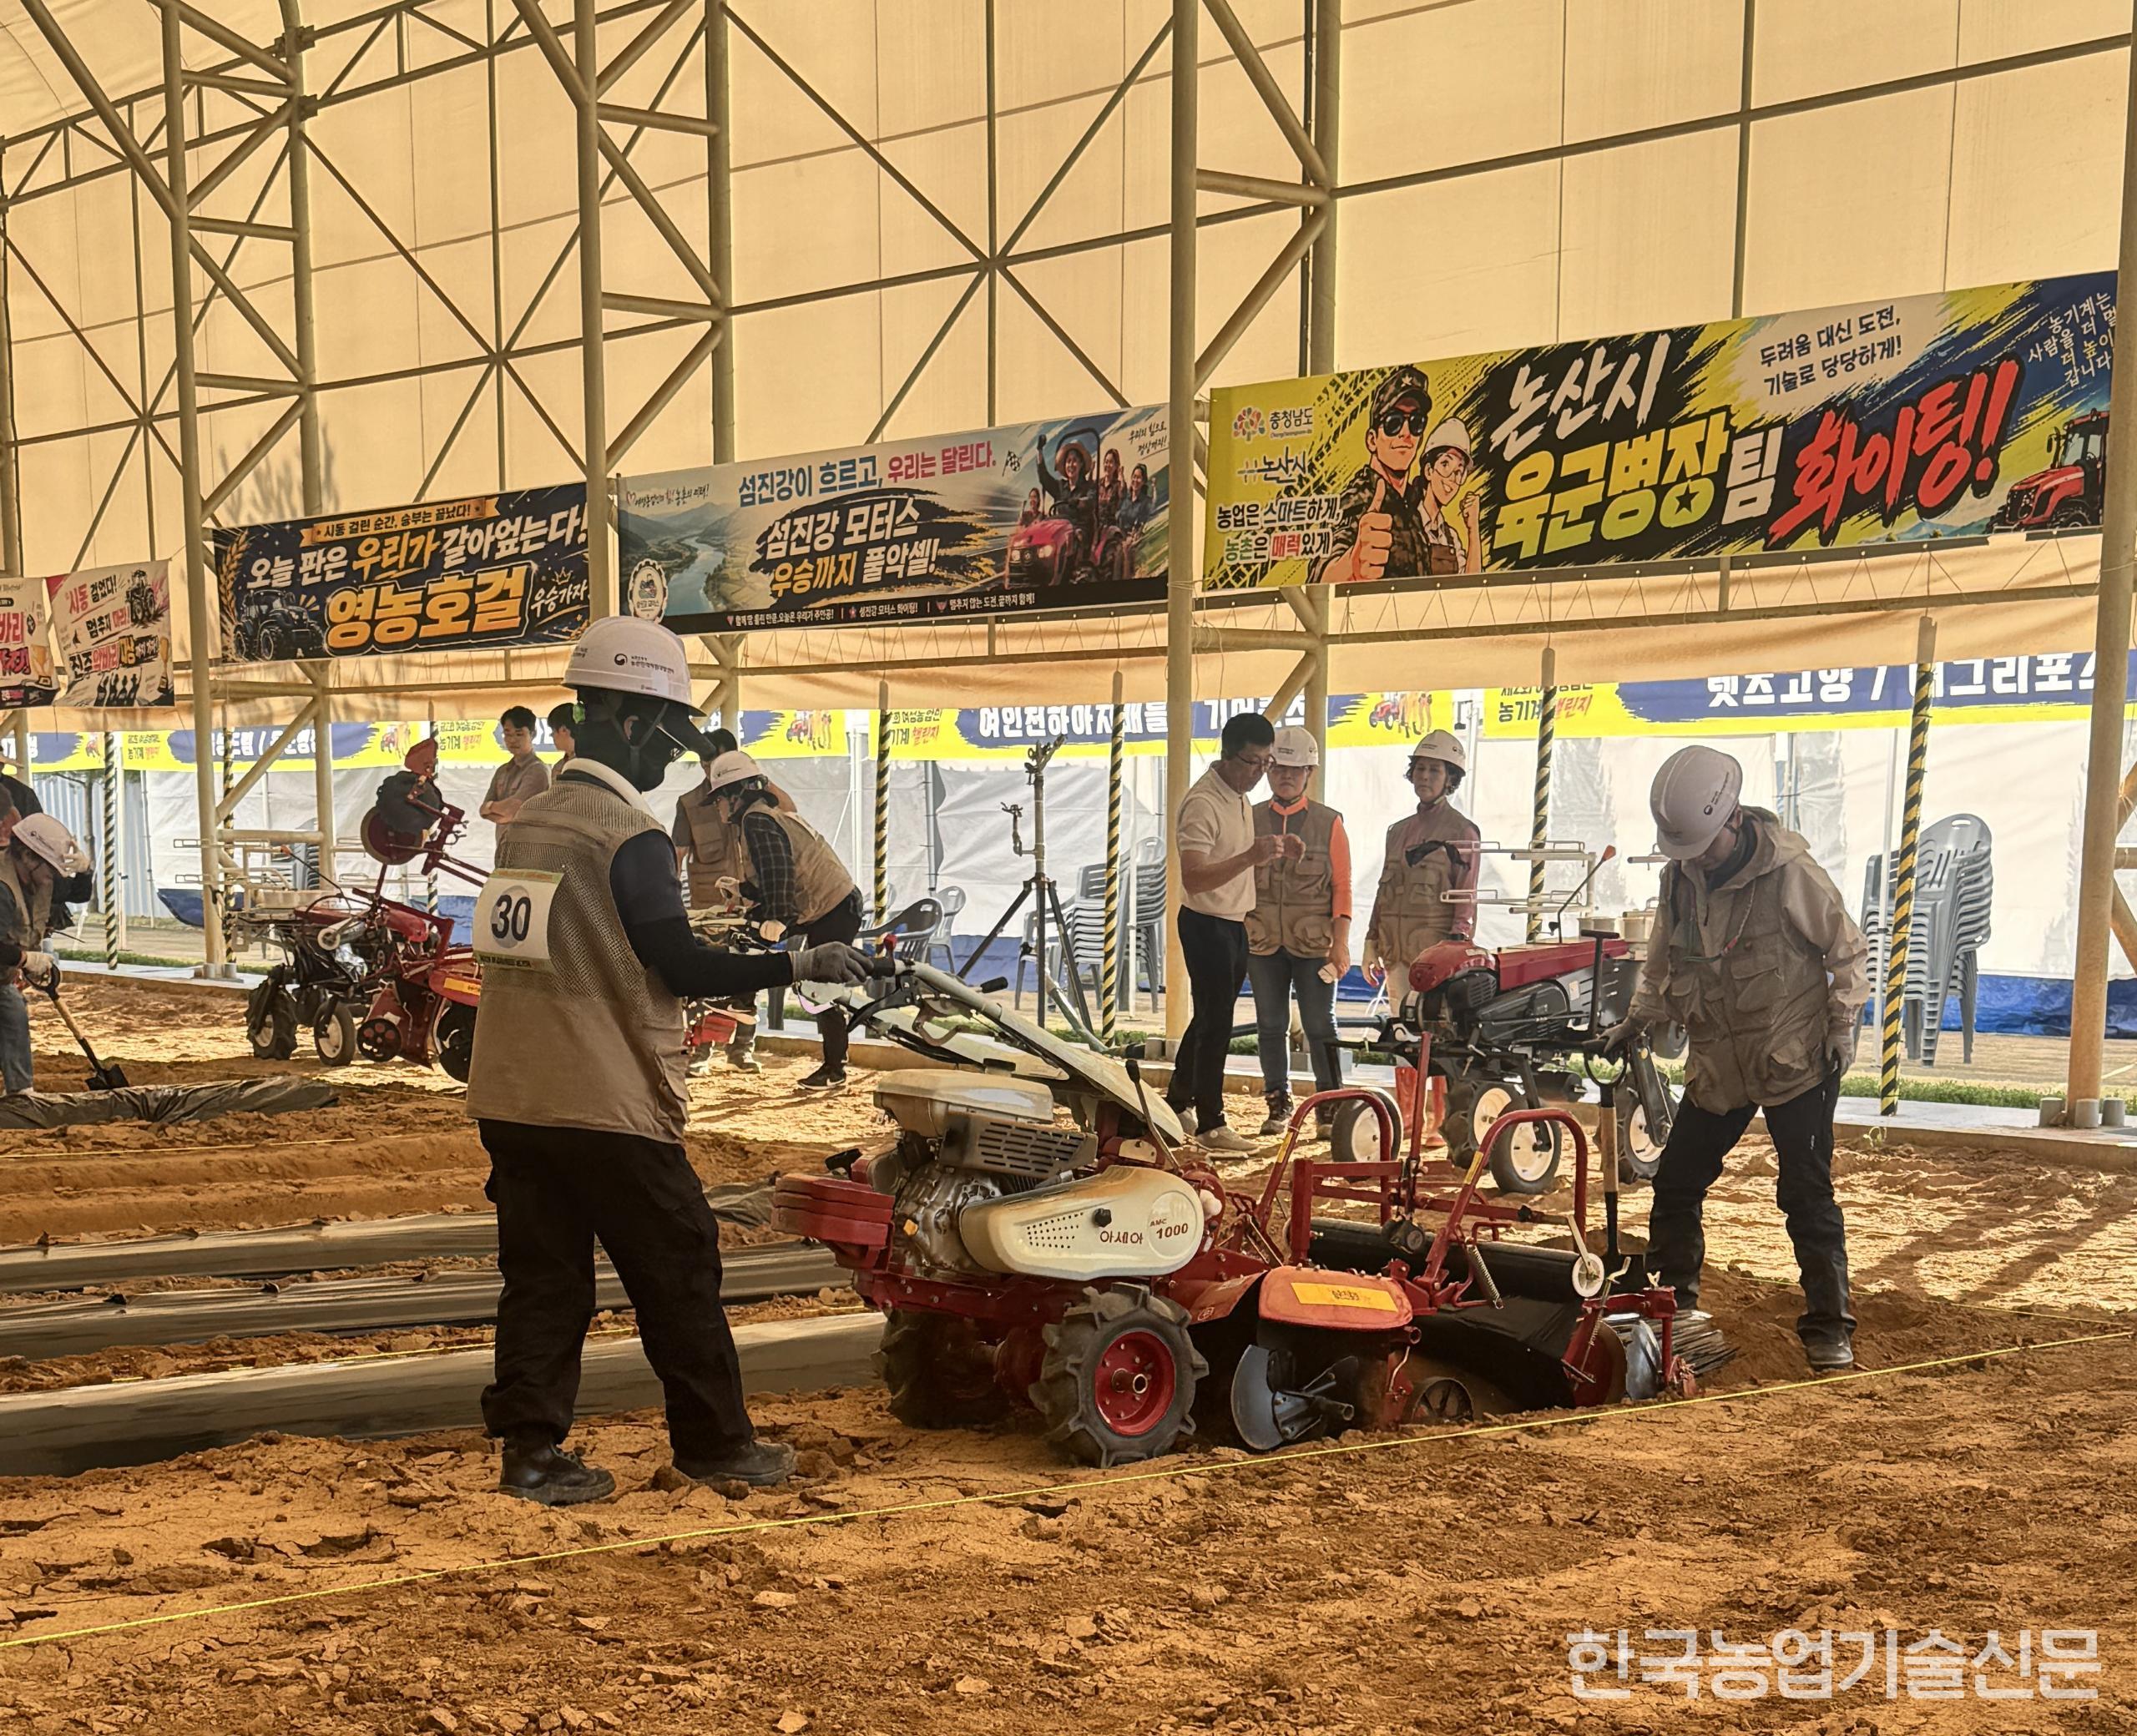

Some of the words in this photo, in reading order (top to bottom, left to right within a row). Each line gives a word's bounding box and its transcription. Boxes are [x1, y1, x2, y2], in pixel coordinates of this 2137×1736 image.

[1760, 333, 1811, 367] 두려움
[1816, 318, 1853, 349] 대신
[1858, 305, 1902, 335] 도전,
[2028, 328, 2074, 362] 사람을
[2081, 317, 2096, 336] 더
[2060, 347, 2076, 366] 더
[2082, 328, 2114, 360] 높이
[1764, 362, 1816, 396] 기술로
[1821, 335, 1902, 378] 당당하게!
[2064, 351, 2112, 387] 갑니다
[1489, 333, 1671, 462] 논산시
[1269, 407, 1313, 431] 충청남도
[739, 465, 812, 507] 섬진강이
[819, 455, 883, 494] 흐르고,
[887, 452, 936, 482] 우리는
[942, 441, 997, 476] 달린다.
[324, 523, 346, 537] 시동
[349, 519, 371, 534] 걸린
[374, 515, 398, 530] 순간,
[401, 511, 432, 527] 승부는
[765, 507, 840, 560] 섬진강
[842, 497, 921, 547] 모터스
[1217, 503, 1260, 529] 농업은
[1263, 497, 1341, 525] 스마트하게,
[246, 555, 296, 589] 오늘
[299, 545, 348, 587] 판은
[351, 527, 442, 582] 우리가
[770, 551, 859, 598] 우승까지
[862, 538, 940, 584] 풀악셀!
[1225, 537, 1268, 563] 농촌은
[1271, 532, 1331, 558] 매력있게
[327, 564, 528, 649] 영농호걸
[889, 728, 910, 745] 기계
[491, 894, 532, 941] 30
[1099, 1230, 1144, 1244] 아세아
[1149, 1219, 1168, 1227] AMC
[1156, 1223, 1189, 1239] 1000
